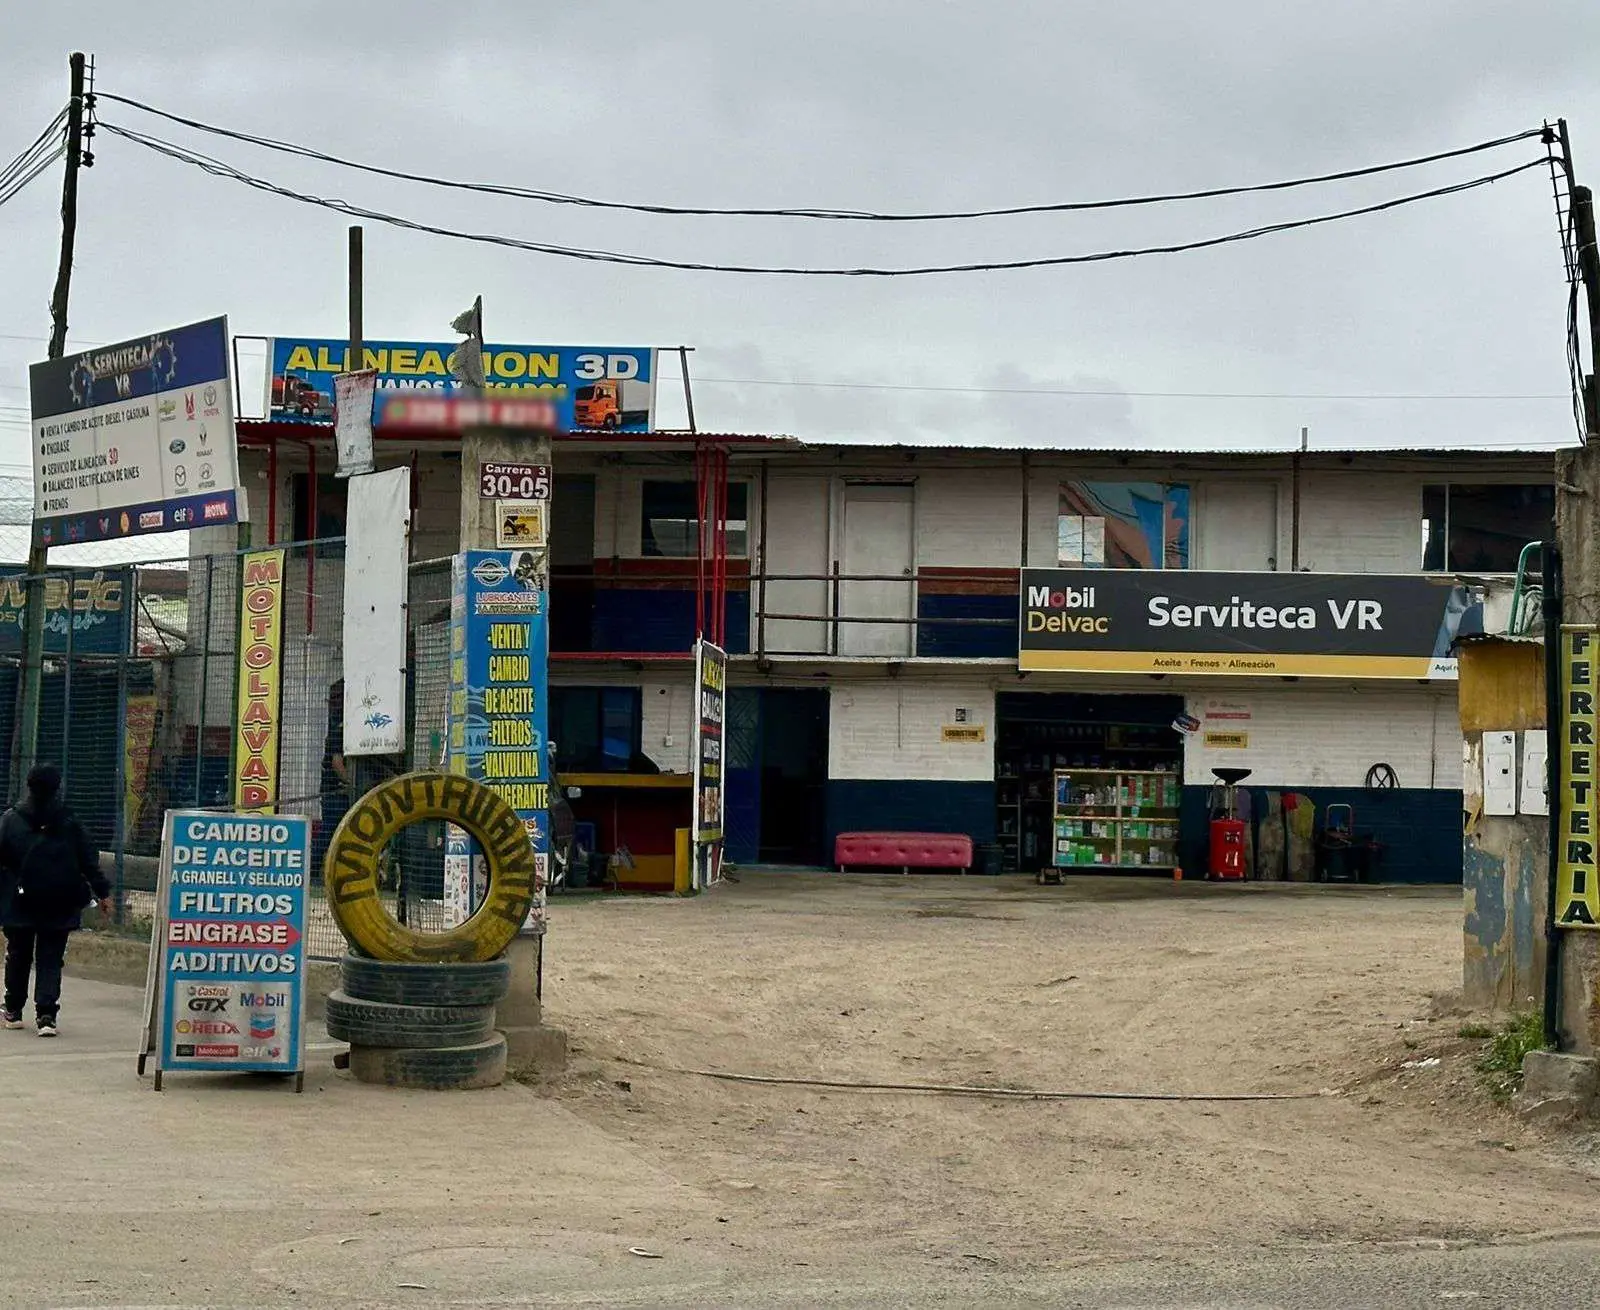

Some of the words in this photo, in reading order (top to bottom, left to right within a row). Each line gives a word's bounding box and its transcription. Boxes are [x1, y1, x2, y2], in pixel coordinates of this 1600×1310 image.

[95, 344, 150, 371] SERVITECA
[575, 353, 640, 380] 3D
[115, 373, 131, 394] VR
[81, 418, 88, 431] DE
[88, 416, 103, 429] ACEITE
[105, 412, 121, 425] DIESEL
[126, 406, 150, 420] GASOLINA
[47, 461, 70, 475] SERVICIO
[70, 459, 77, 471] DE
[108, 447, 119, 465] 3D
[485, 464, 532, 475] Carrera
[539, 466, 546, 476] 3
[48, 477, 74, 493] BALANCEO
[79, 470, 115, 488] RECTIFICACION
[116, 468, 124, 481] DE
[124, 466, 140, 480] RINES
[482, 474, 549, 499] 30-05
[48, 497, 69, 511] FRENOS
[1028, 585, 1094, 608] Mobil
[1027, 611, 1108, 634] Delvac
[1147, 595, 1315, 630] Serviteca
[1327, 599, 1383, 631] VR
[523, 623, 531, 649] Y
[489, 655, 530, 682] CAMBIO
[1153, 658, 1182, 667] Aceite
[1190, 658, 1220, 668] Frenos
[1228, 658, 1275, 669] Alineación
[241, 558, 281, 814] MOTOLAVAD
[485, 688, 499, 714] DE
[500, 688, 534, 714] ACEITE
[1560, 632, 1597, 924] FERRETERIA
[188, 821, 289, 843] CAMBIO
[173, 845, 206, 866] DE
[212, 847, 302, 868] ACEITE
[171, 871, 180, 884] A
[181, 871, 237, 886] GRANELL
[239, 873, 248, 885] Y
[248, 873, 303, 887] SELLADO
[180, 891, 293, 916] FILTROS
[168, 922, 288, 945] ENGRASE
[170, 951, 297, 975] ADITIVOS
[197, 986, 230, 997] Castrol
[240, 992, 285, 1007] Mobil
[188, 998, 230, 1013] GTX
